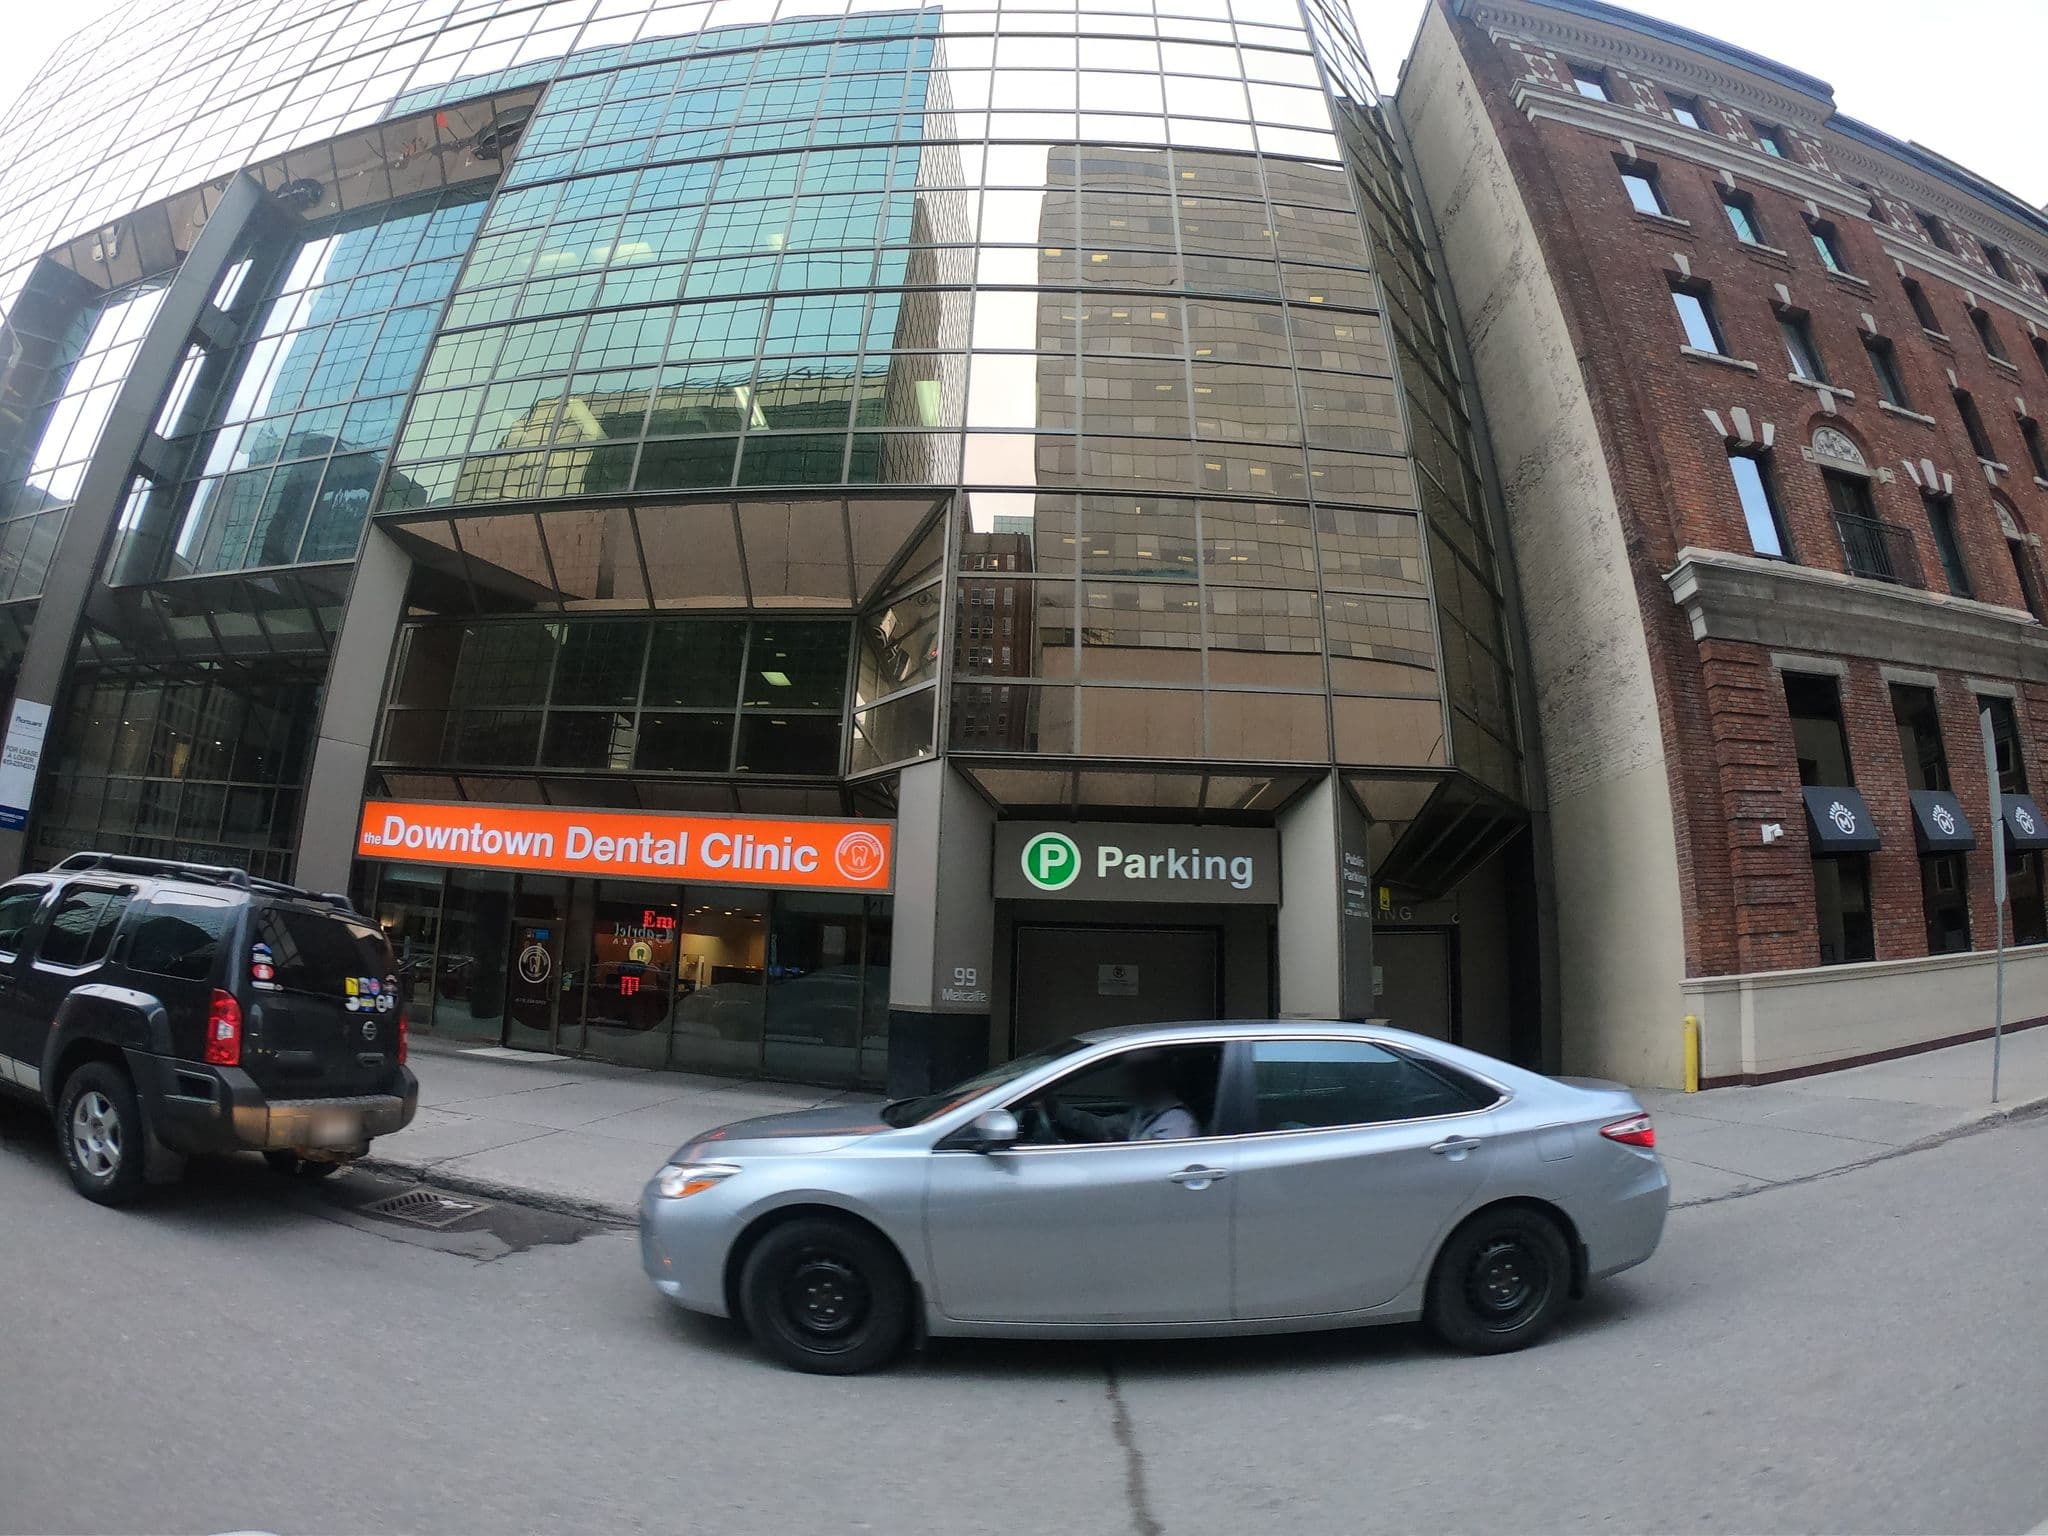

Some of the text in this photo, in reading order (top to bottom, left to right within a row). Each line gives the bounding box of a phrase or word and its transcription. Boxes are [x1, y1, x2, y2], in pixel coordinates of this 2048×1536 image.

[364, 832, 382, 846] the
[382, 815, 555, 858] Downtown
[565, 825, 689, 866] Dental
[701, 832, 819, 873] Clinic
[1039, 843, 1254, 890] P Parking
[953, 967, 977, 987] 99
[941, 988, 987, 1002] Metcalfe
